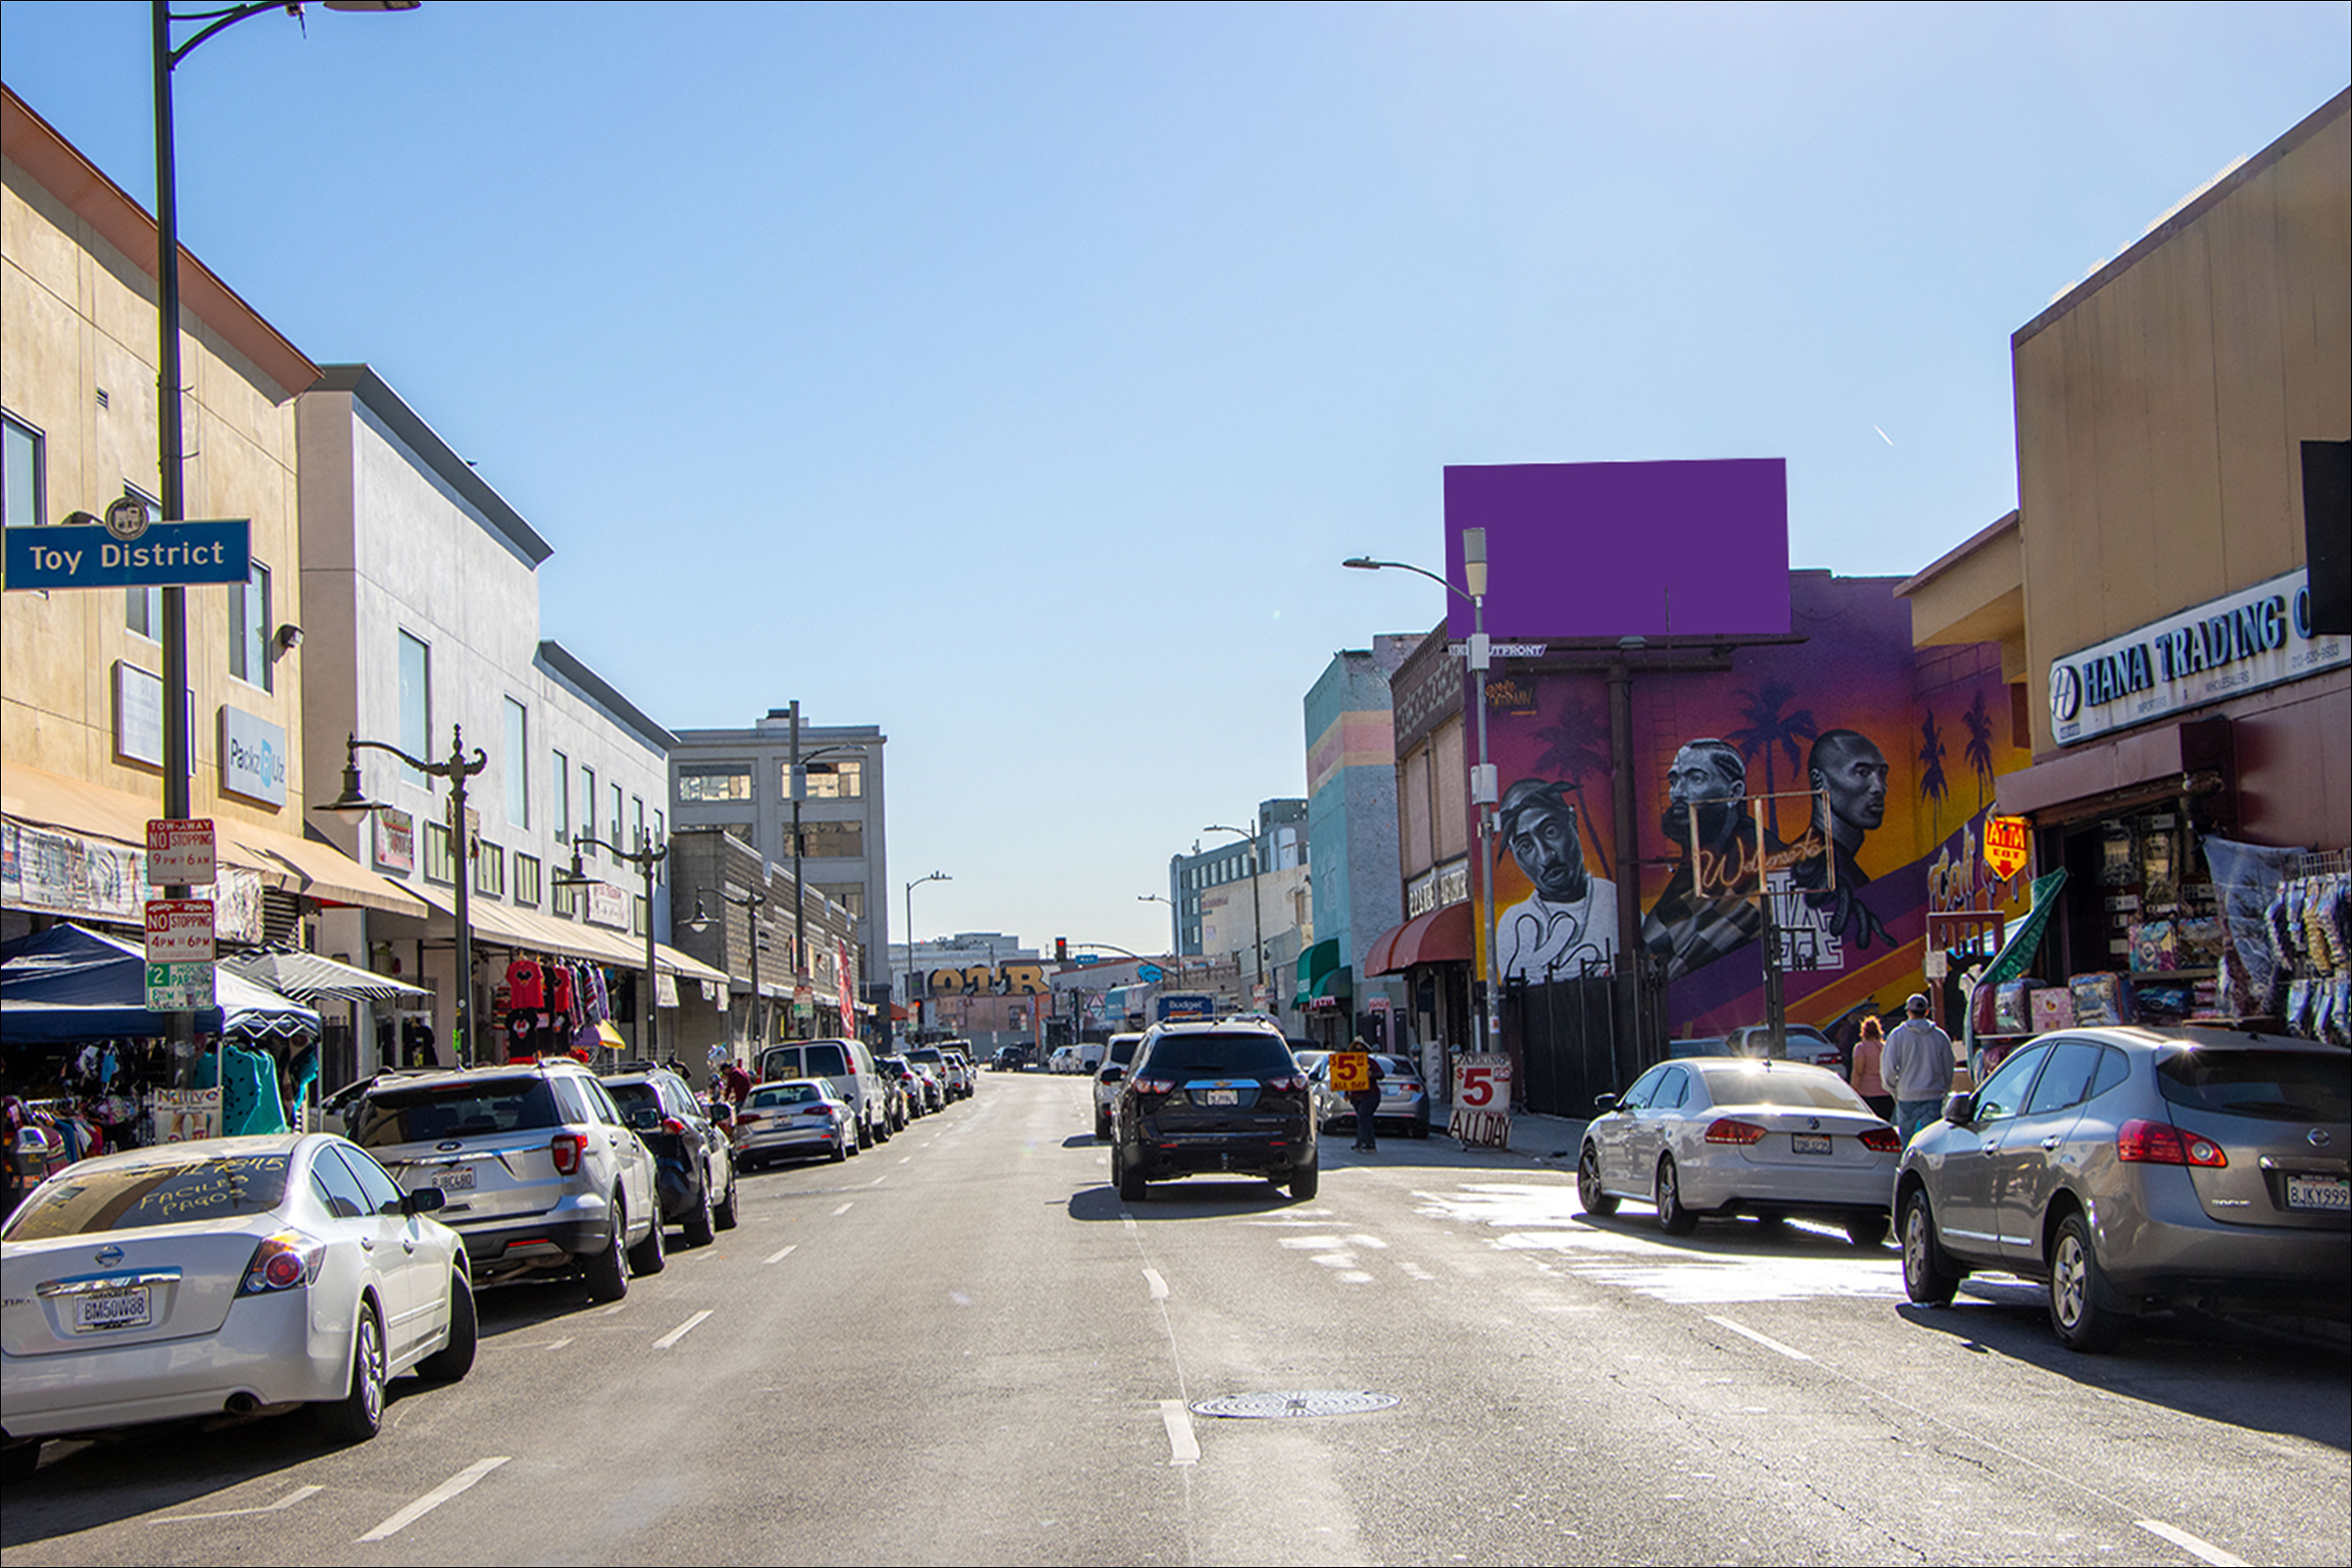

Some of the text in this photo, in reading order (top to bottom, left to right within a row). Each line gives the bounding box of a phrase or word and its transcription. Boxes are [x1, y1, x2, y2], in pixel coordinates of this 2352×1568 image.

[29, 541, 224, 575] Toy District
[1489, 644, 1543, 658] UTFRONT
[2082, 643, 2153, 708] HANA
[2156, 594, 2286, 682] TRADING
[150, 821, 211, 831] TOW-AWAY
[149, 832, 213, 849] NO STOPPING
[1700, 836, 1801, 888] Welome
[148, 913, 211, 930] NO STOPPING
[154, 967, 164, 984] 2
[1168, 1000, 1203, 1010] Budget
[1450, 1110, 1512, 1149] ALL DAY
[2290, 1186, 2349, 1204] 8JKY999
